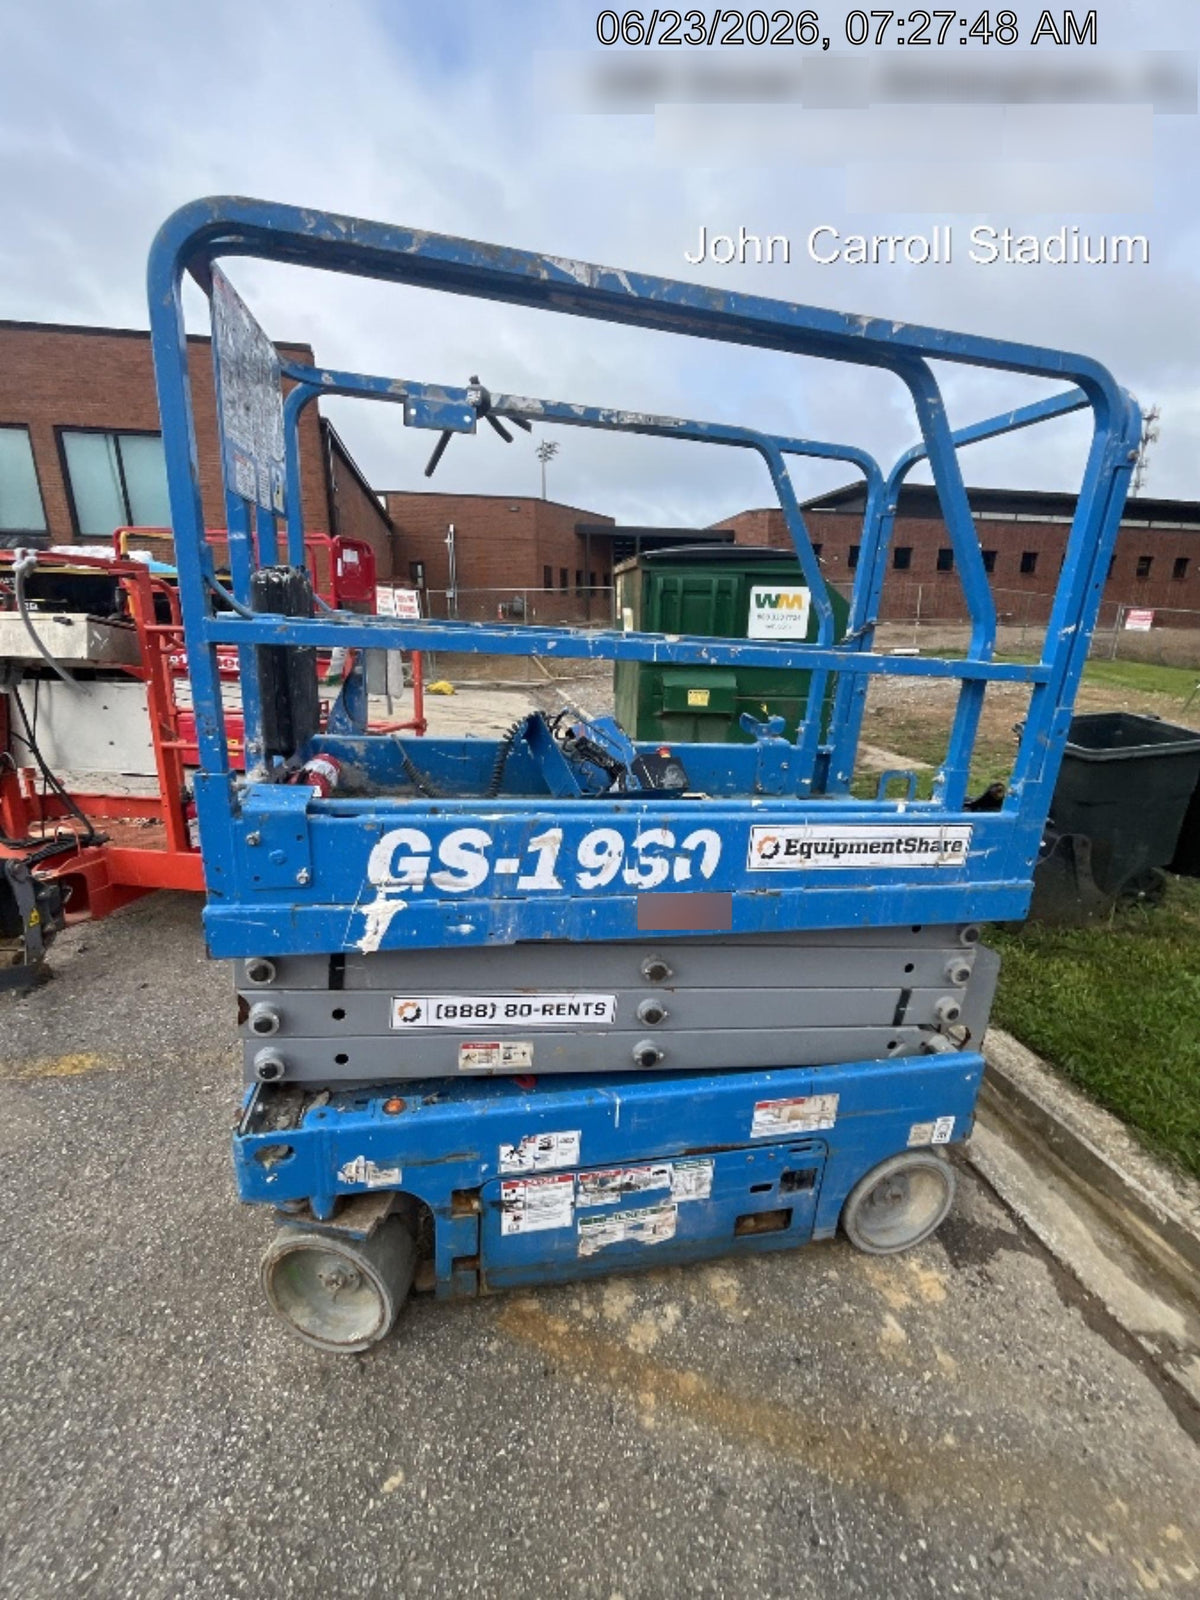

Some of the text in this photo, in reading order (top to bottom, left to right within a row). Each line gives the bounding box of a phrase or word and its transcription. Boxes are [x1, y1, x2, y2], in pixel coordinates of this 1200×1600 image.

[755, 593, 803, 610] WM
[784, 837, 963, 859] EquipmentShare
[504, 1002, 607, 1018] 80-RENTS
